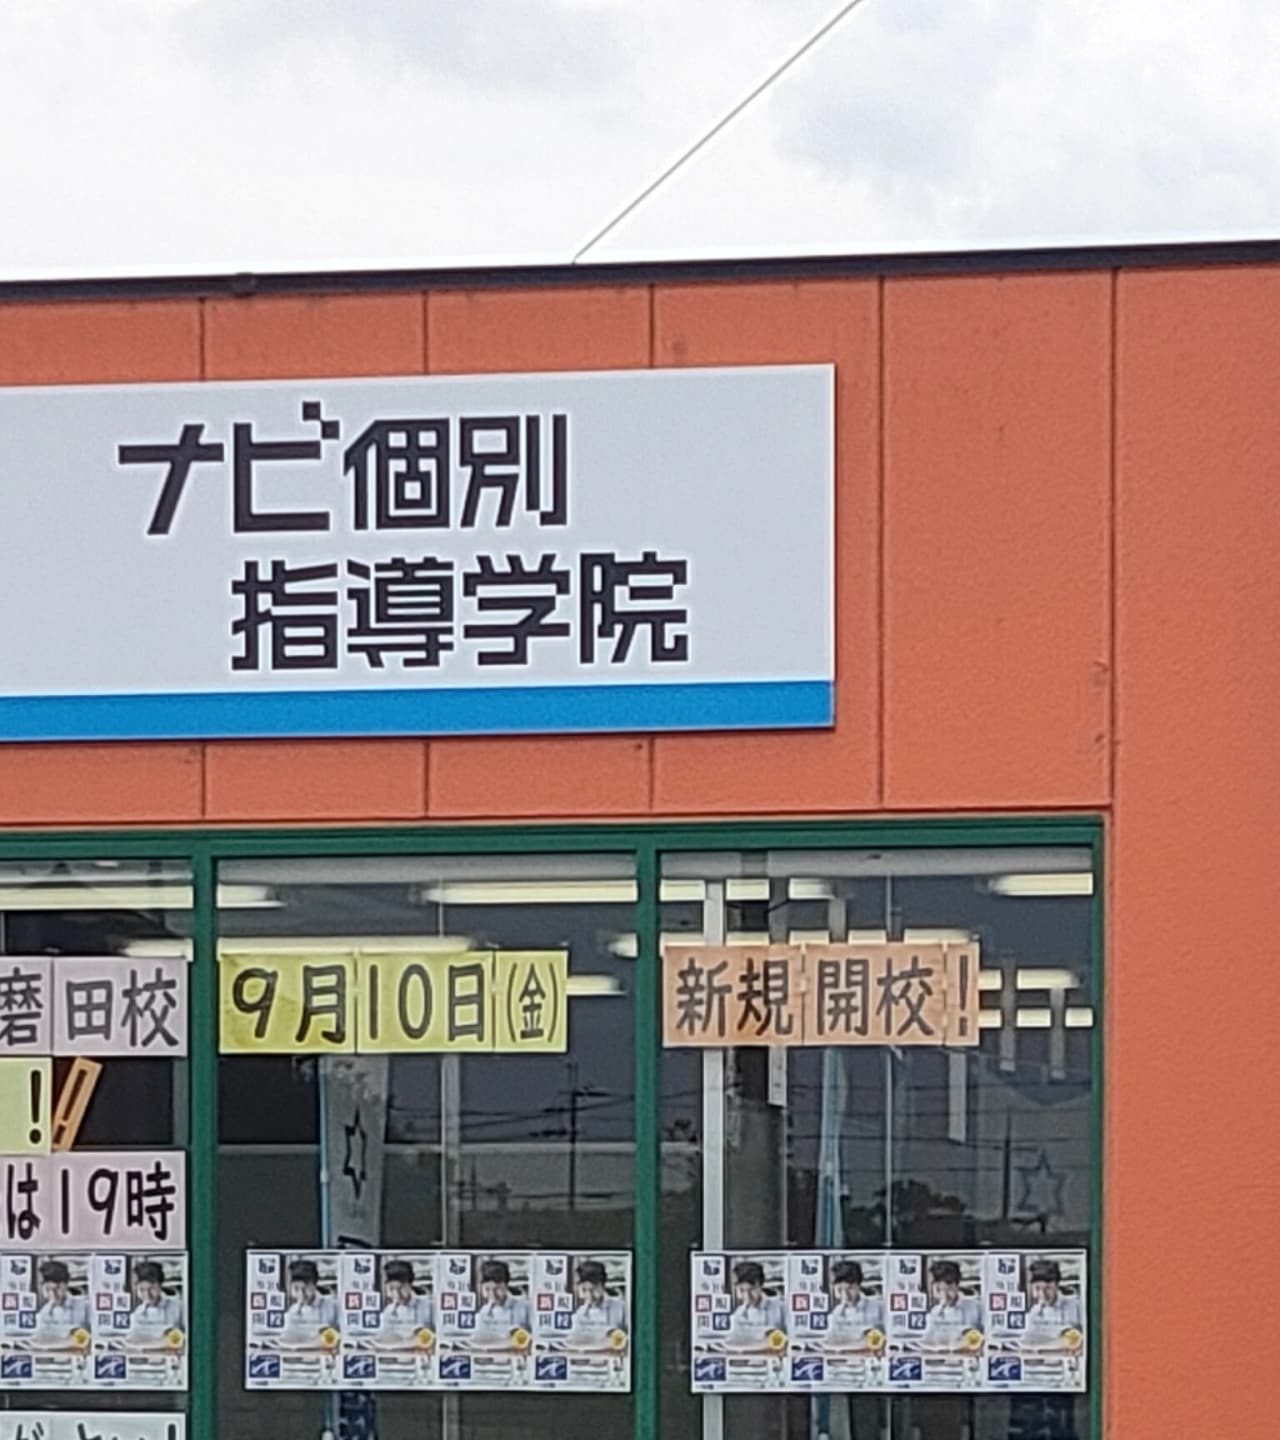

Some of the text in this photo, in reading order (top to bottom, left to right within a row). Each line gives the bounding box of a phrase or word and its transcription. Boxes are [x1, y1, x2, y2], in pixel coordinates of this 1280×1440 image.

[118, 401, 568, 535] ナビ個別
[232, 552, 688, 672] 指導学院
